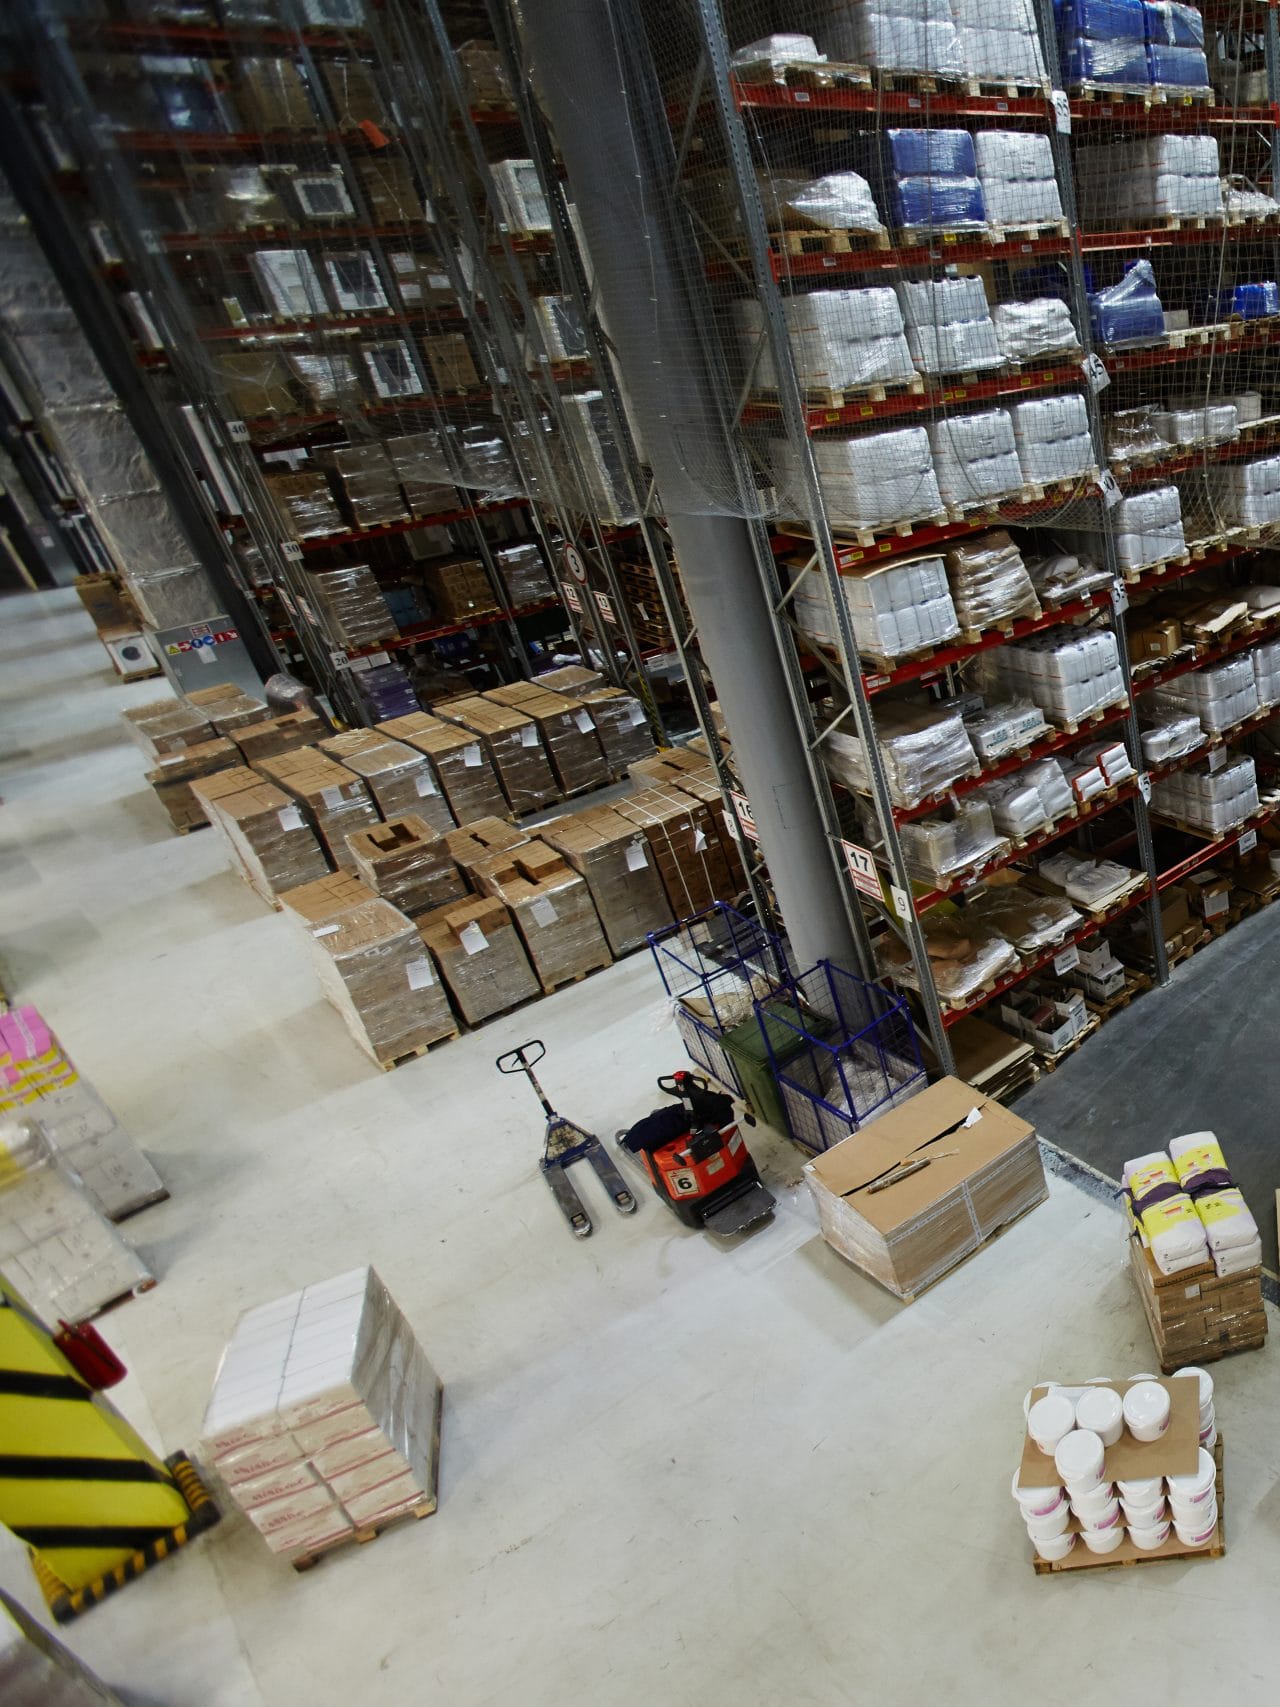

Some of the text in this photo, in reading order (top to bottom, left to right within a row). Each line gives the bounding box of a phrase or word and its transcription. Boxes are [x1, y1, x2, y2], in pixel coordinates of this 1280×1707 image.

[232, 424, 247, 435] 40
[285, 543, 300, 555] 30
[570, 554, 580, 573] 3
[336, 656, 349, 666] 20
[850, 851, 868, 872] 17
[897, 896, 906, 911] 9
[677, 1177, 693, 1190] 6
